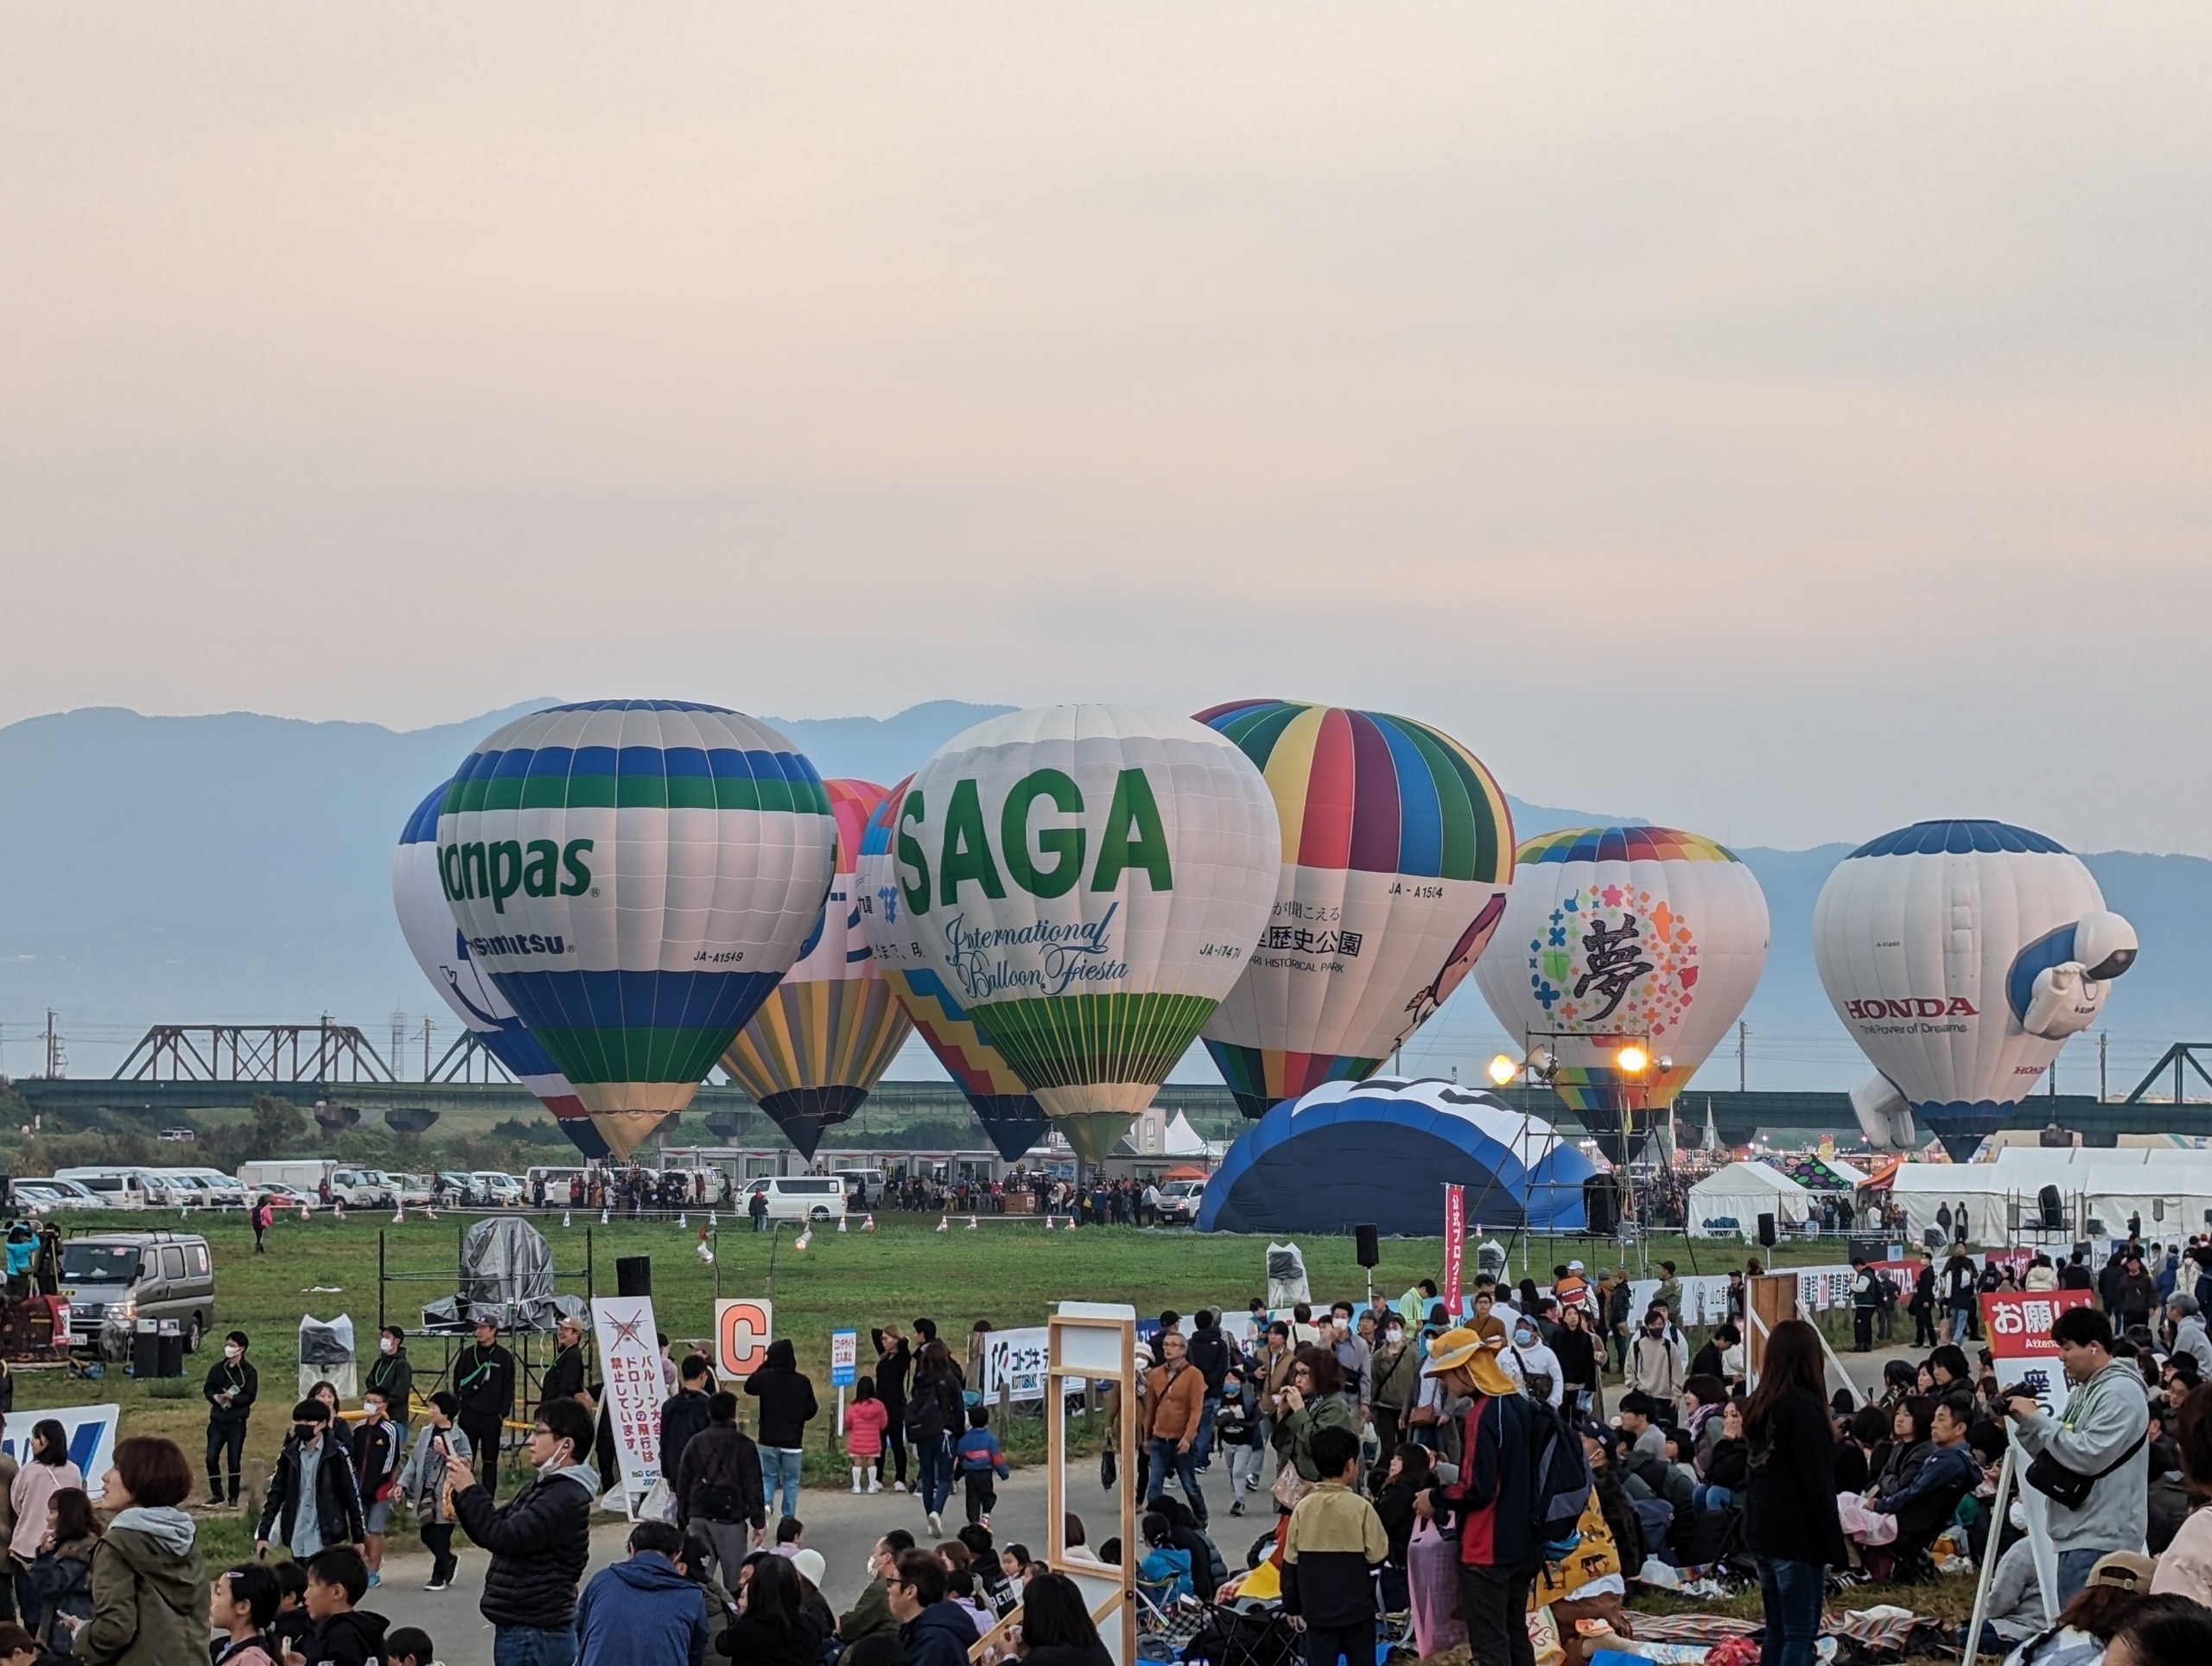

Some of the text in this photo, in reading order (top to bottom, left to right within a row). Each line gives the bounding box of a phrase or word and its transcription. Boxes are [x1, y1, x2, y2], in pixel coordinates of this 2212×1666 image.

[898, 768, 1173, 916] SAGA
[693, 951, 744, 963] JA-A1549
[945, 901, 1118, 966] International
[957, 951, 1044, 998] Balloon
[1039, 944, 1128, 995] Fiesta
[1265, 957, 1317, 972] HISTORICAL
[1320, 962, 1344, 973] PARK
[1573, 912, 1655, 1021] 夢
[1845, 997, 1980, 1020] HONDA
[1859, 1022, 1967, 1035] The Power of Dreams
[721, 1304, 766, 1376] C
